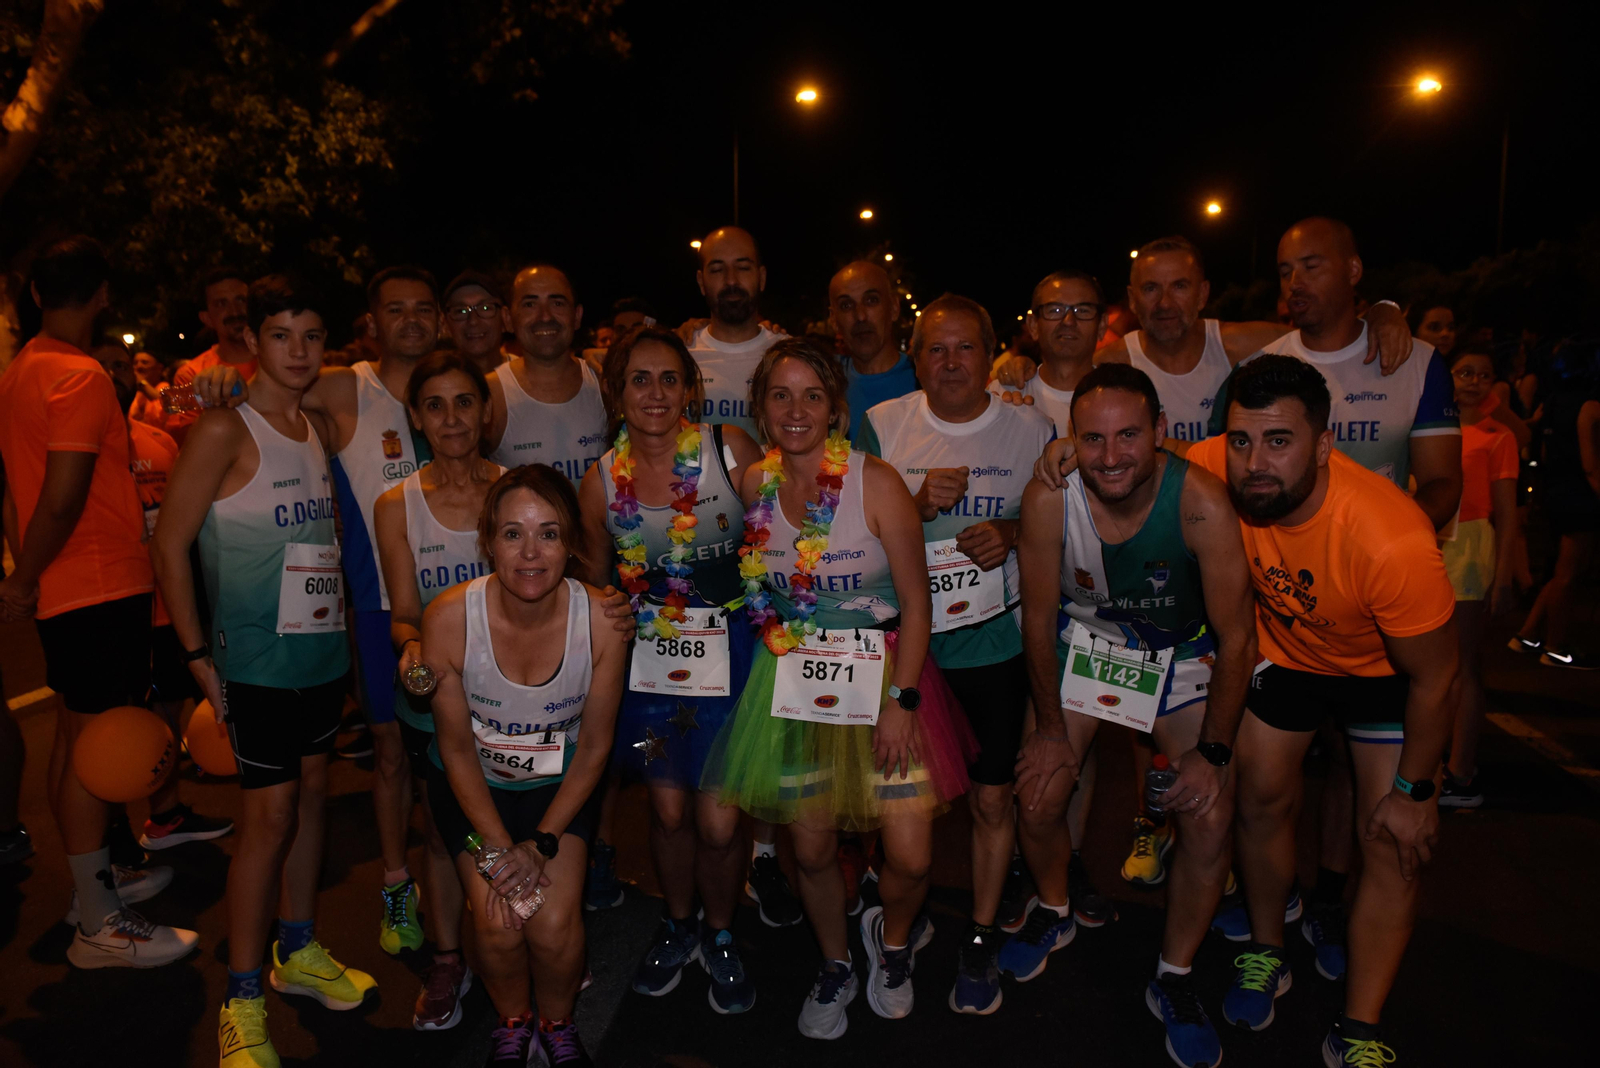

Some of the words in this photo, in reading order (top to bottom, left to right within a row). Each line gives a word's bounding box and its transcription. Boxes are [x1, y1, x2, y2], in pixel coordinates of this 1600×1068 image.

[513, 441, 542, 452] FASTER
[971, 467, 1012, 478] Beiman
[273, 478, 301, 489] FASTER
[821, 550, 866, 564] Beiman
[305, 577, 339, 595] 6008
[929, 569, 981, 594] 5872
[656, 639, 705, 658] 5868
[802, 659, 854, 683] 5871
[1091, 660, 1141, 689] 1142
[471, 693, 502, 708] FASTER
[816, 698, 835, 706] KH7
[480, 747, 534, 773] 5864
